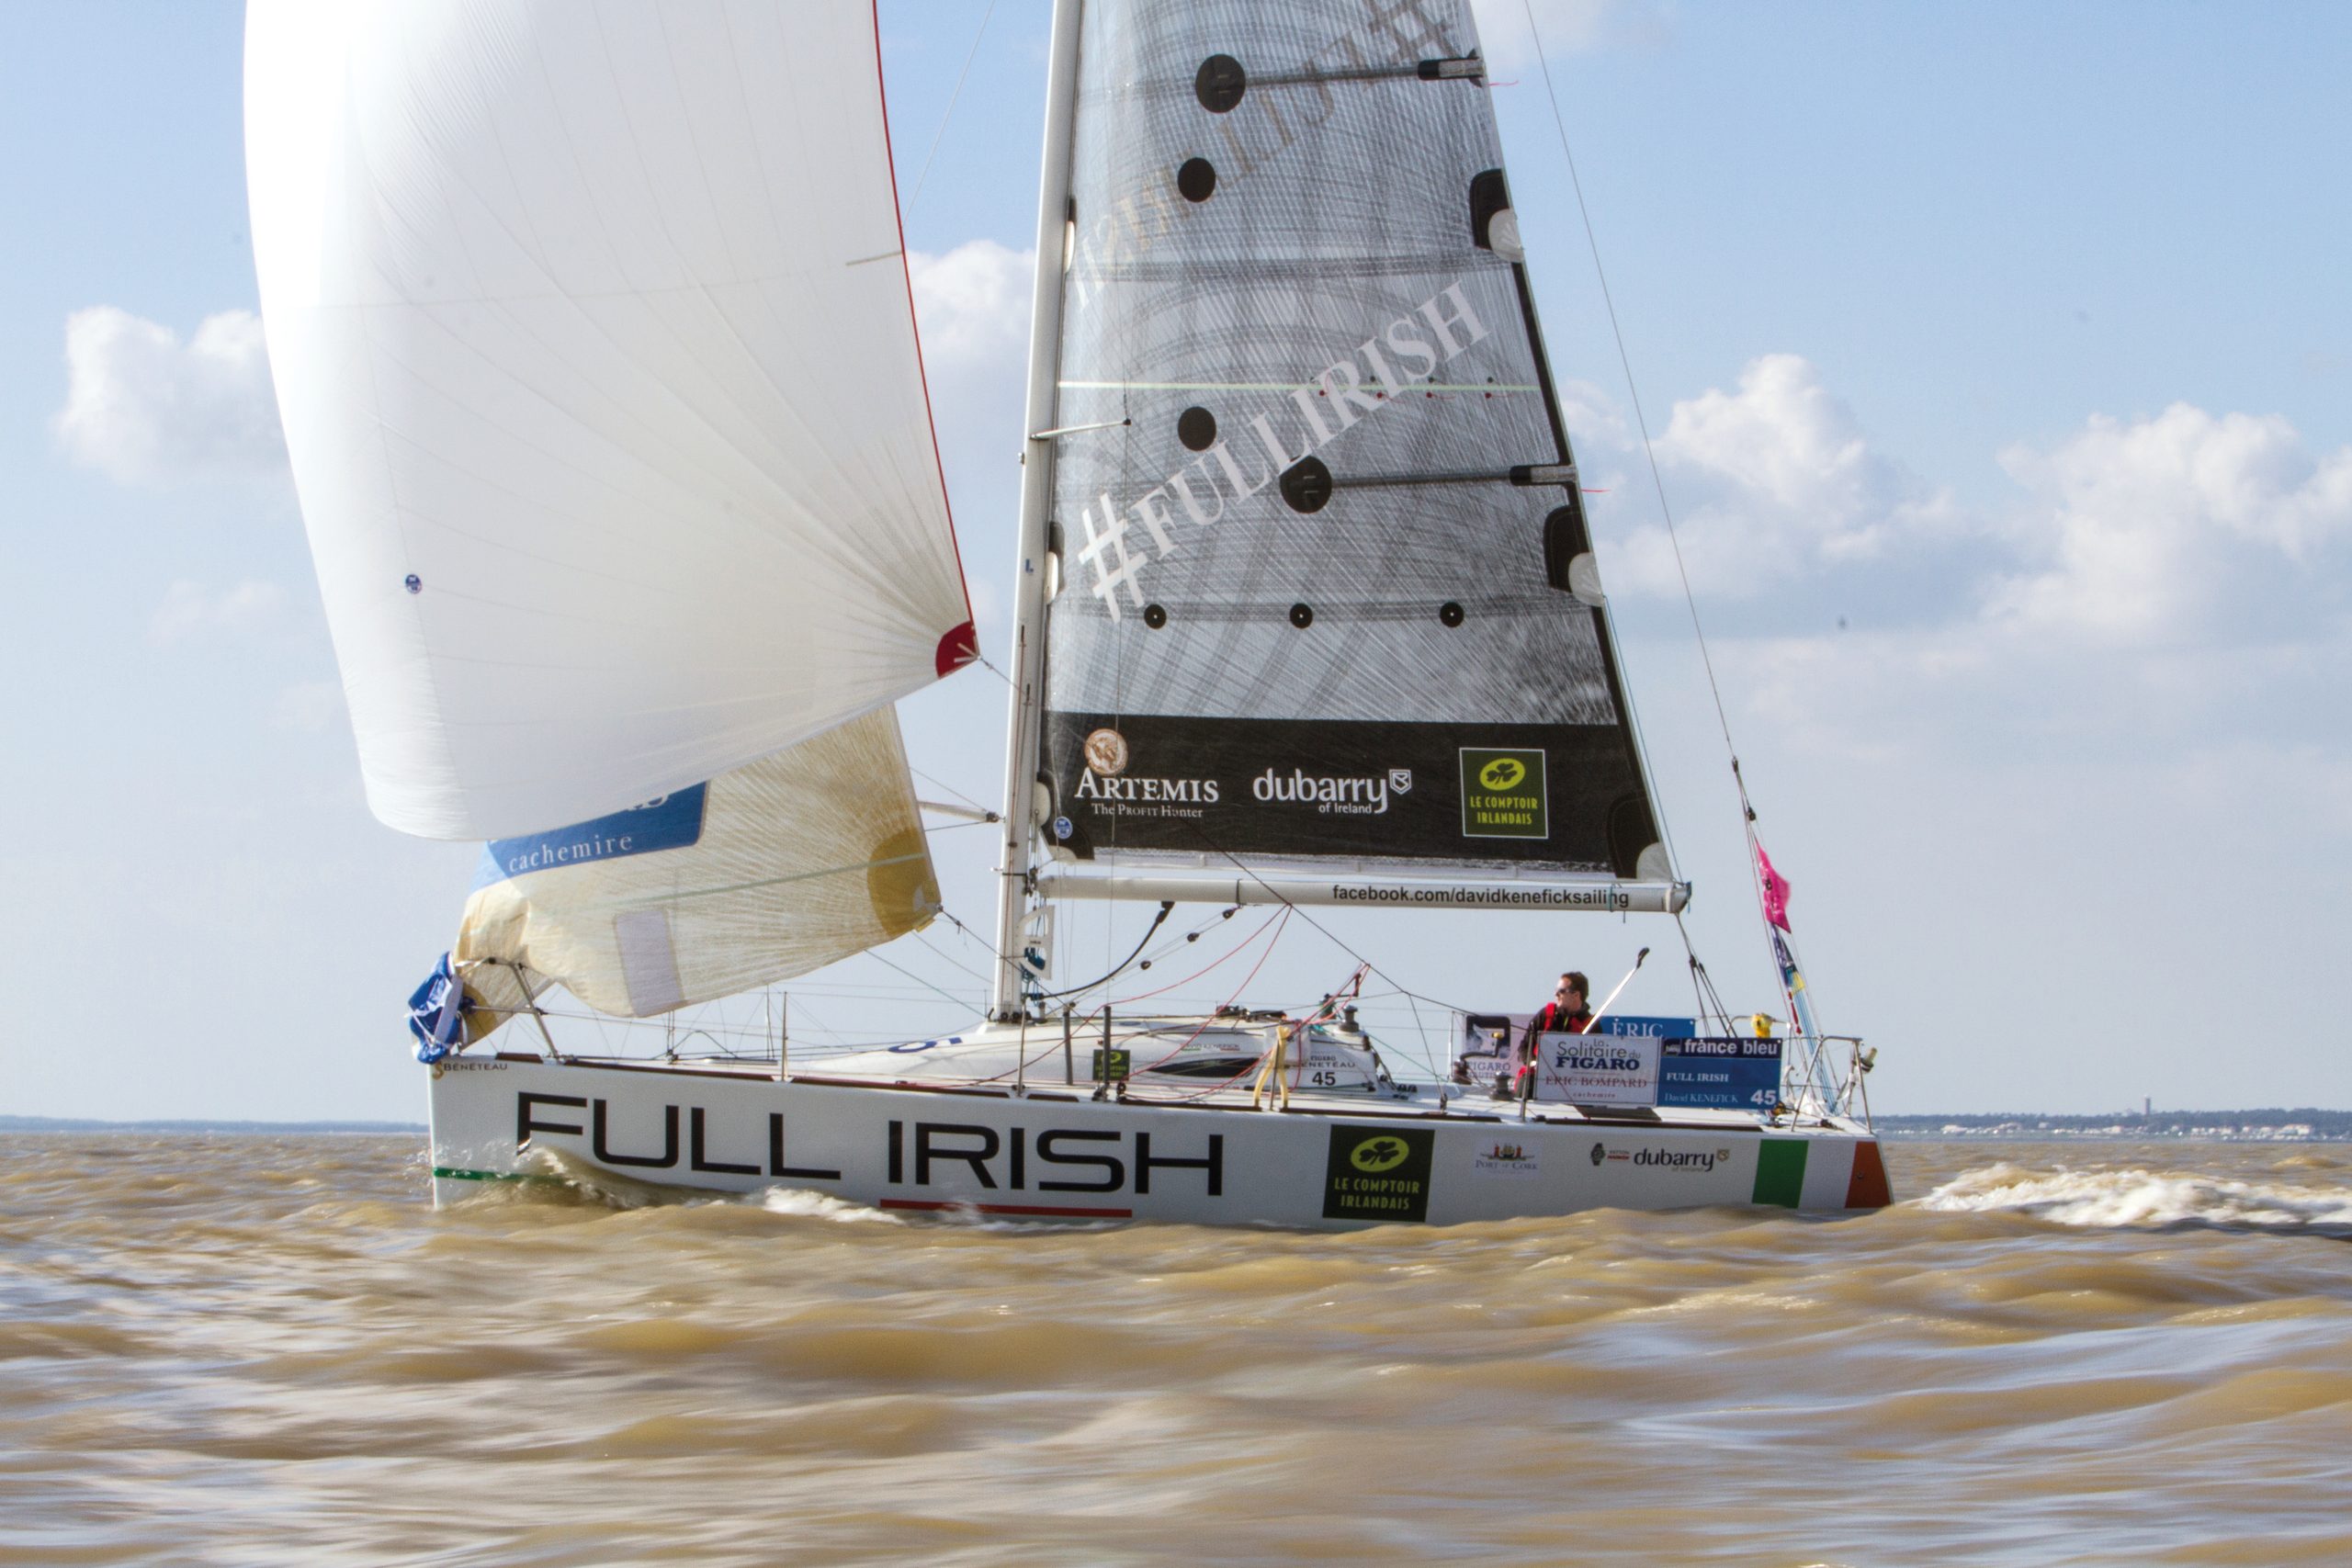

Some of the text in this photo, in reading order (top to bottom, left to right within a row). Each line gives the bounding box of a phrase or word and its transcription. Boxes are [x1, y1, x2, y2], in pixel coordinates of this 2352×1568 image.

[1078, 280, 1491, 625] #FULLIRISH
[1074, 766, 1219, 803] ARTEMIS
[1252, 768, 1388, 814] dubarry
[1318, 802, 1373, 814] of Ireland
[1470, 795, 1538, 809] LE COMPTOIR
[1091, 803, 1203, 818] The PROFIT Hunter
[1476, 811, 1532, 825] IRLANDAIS
[508, 834, 633, 873] cachemire
[1333, 885, 1629, 908] facebook.com/davidkeneficksailing
[1556, 1040, 1627, 1058] Solitaire
[1685, 1039, 1737, 1055] france
[1743, 1040, 1778, 1055] bleu
[1555, 1056, 1640, 1071] FIGARO
[1312, 1072, 1336, 1087] 45
[1581, 1077, 1647, 1089] BOMPARD
[1667, 1072, 1729, 1083] FULL IRISH
[1750, 1089, 1777, 1106] 45
[516, 1092, 1223, 1197] FULL IRISH
[1634, 1147, 1714, 1172] dubarry
[1334, 1178, 1420, 1193] LE COMPTOIR
[1341, 1195, 1410, 1210] IRLANDAIS
